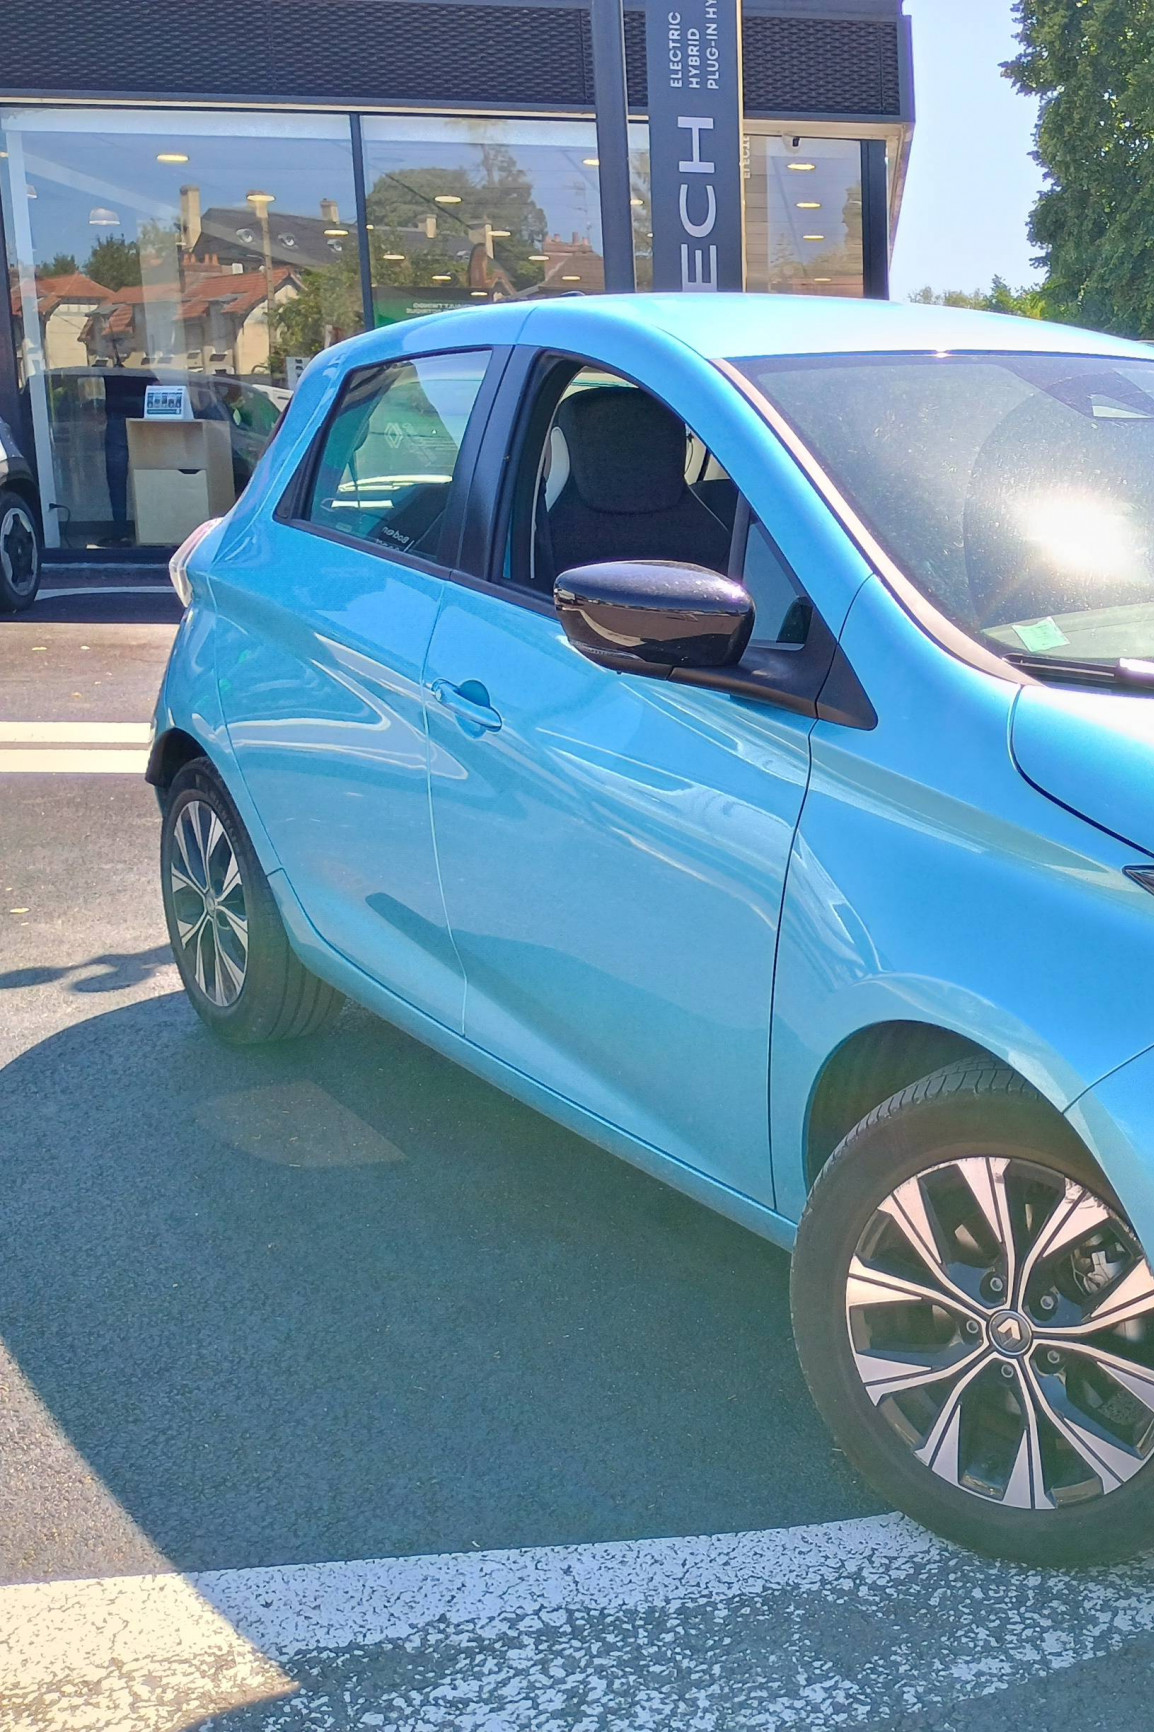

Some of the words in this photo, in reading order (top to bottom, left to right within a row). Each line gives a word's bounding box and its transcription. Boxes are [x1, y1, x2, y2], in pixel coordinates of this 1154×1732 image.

[668, 11, 682, 88] ELECTRIC
[687, 28, 701, 88] HYBRID
[705, 23, 719, 89] PLUG-IN
